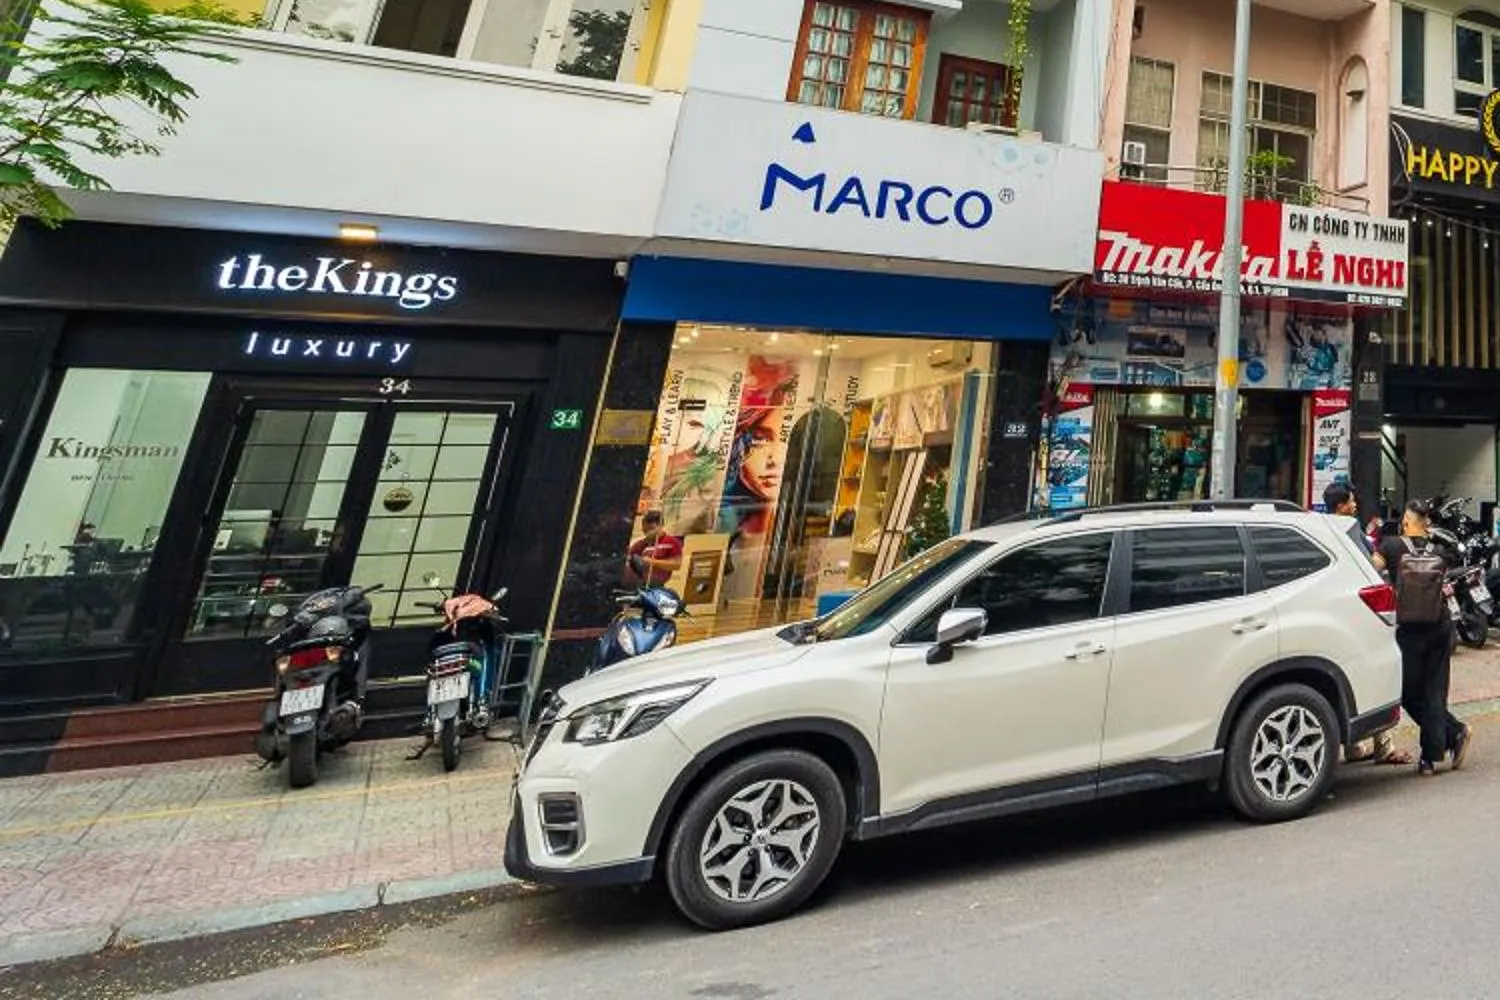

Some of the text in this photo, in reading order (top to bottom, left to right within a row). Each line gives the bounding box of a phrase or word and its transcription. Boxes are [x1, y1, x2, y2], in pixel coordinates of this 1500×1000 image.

[1407, 144, 1499, 189] HAPPY
[759, 162, 993, 229] MARCO
[1289, 212, 1308, 232] CN
[1354, 220, 1368, 240] TY
[1373, 222, 1405, 245] TNHH
[217, 253, 457, 309] theKings
[1332, 253, 1405, 289] NGHI
[246, 331, 411, 363] luxury
[379, 377, 412, 395] 34
[552, 410, 579, 427] 34
